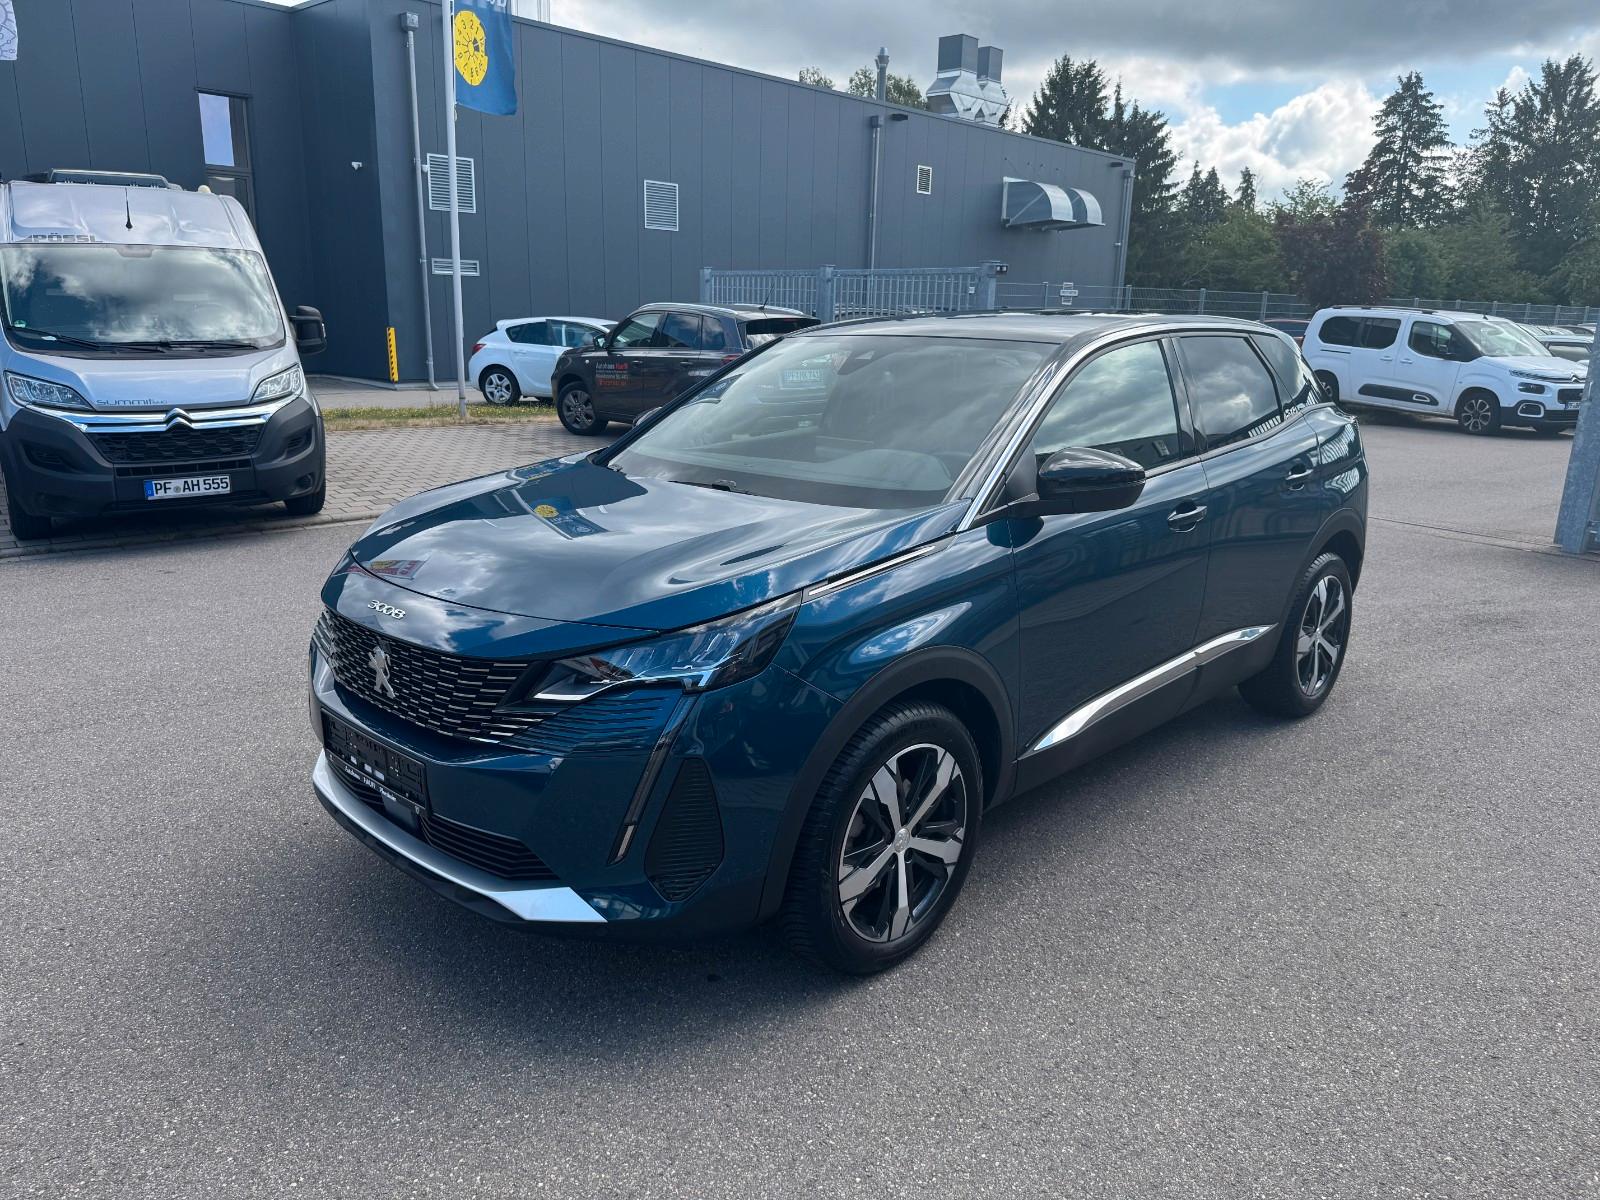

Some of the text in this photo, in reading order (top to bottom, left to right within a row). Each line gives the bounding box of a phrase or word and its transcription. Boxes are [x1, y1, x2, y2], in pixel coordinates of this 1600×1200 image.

[154, 477, 229, 495] PF AH 555
[367, 599, 406, 619] 3008
